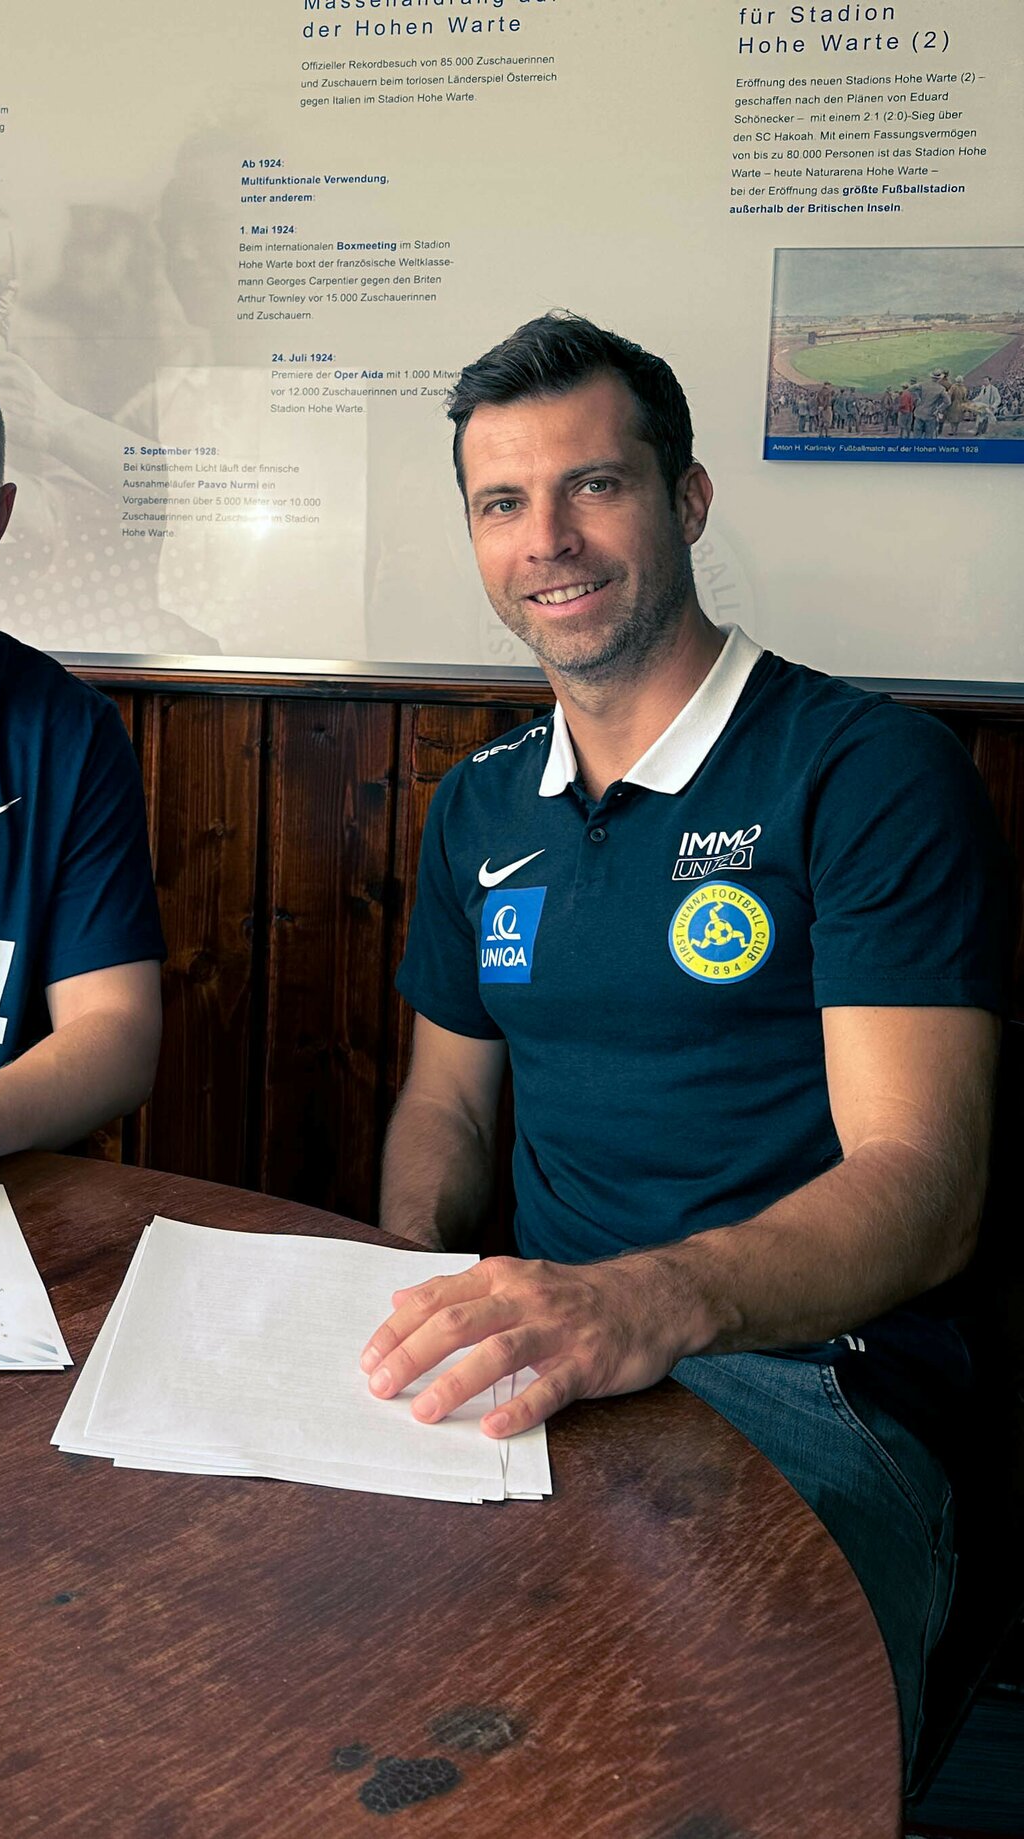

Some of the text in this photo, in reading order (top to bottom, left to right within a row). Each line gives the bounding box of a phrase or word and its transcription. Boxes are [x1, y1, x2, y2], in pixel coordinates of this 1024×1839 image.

[739, 5, 895, 25] für Stadion
[303, 16, 521, 38] der Hohen Warte
[739, 31, 950, 54] Hohe Warte (2)
[301, 55, 555, 71] Offizieller Rekordbesuch von 85.000 Zuschauerinnen
[301, 73, 557, 88] und Zuschauern beim torlosen Länderspiel Österreich
[301, 93, 477, 108] gegen Italien im Stadion Hohe Warte.
[735, 92, 949, 108] geschaffen nach den Plänen von Eduard
[733, 133, 752, 142] den
[755, 132, 771, 142] SC
[820, 131, 836, 140] Mit
[839, 130, 870, 140] einem
[874, 129, 977, 140] Fassungsvermögen
[242, 159, 284, 168] Ab 1924:
[241, 175, 389, 186] Multifunktionale Verwendung,
[730, 184, 965, 197] bei der Eröffnung das größte Fußballstadion
[241, 193, 316, 203] unter anderem:
[730, 203, 904, 214] außerhalb der Britischen Inseln.
[240, 226, 297, 234] 1. Mai 1924:
[239, 241, 451, 252] Beim internationalen Boxmeeting im Stadion
[238, 275, 442, 287] mann Georges Carpentier gegen den Briten
[272, 353, 336, 363] 24. Juli 1924:
[270, 404, 367, 414] Stadion Hohe Warte.
[124, 447, 219, 458] 25. September 1928:
[888, 445, 899, 453] auf
[901, 445, 912, 453] der
[679, 824, 762, 856] IMMO
[679, 851, 746, 877] UNITED
[676, 888, 766, 964] FIRST VIENNA FOOTBALL CLUB
[482, 947, 527, 968] UNIQA
[704, 963, 741, 975] 1894
